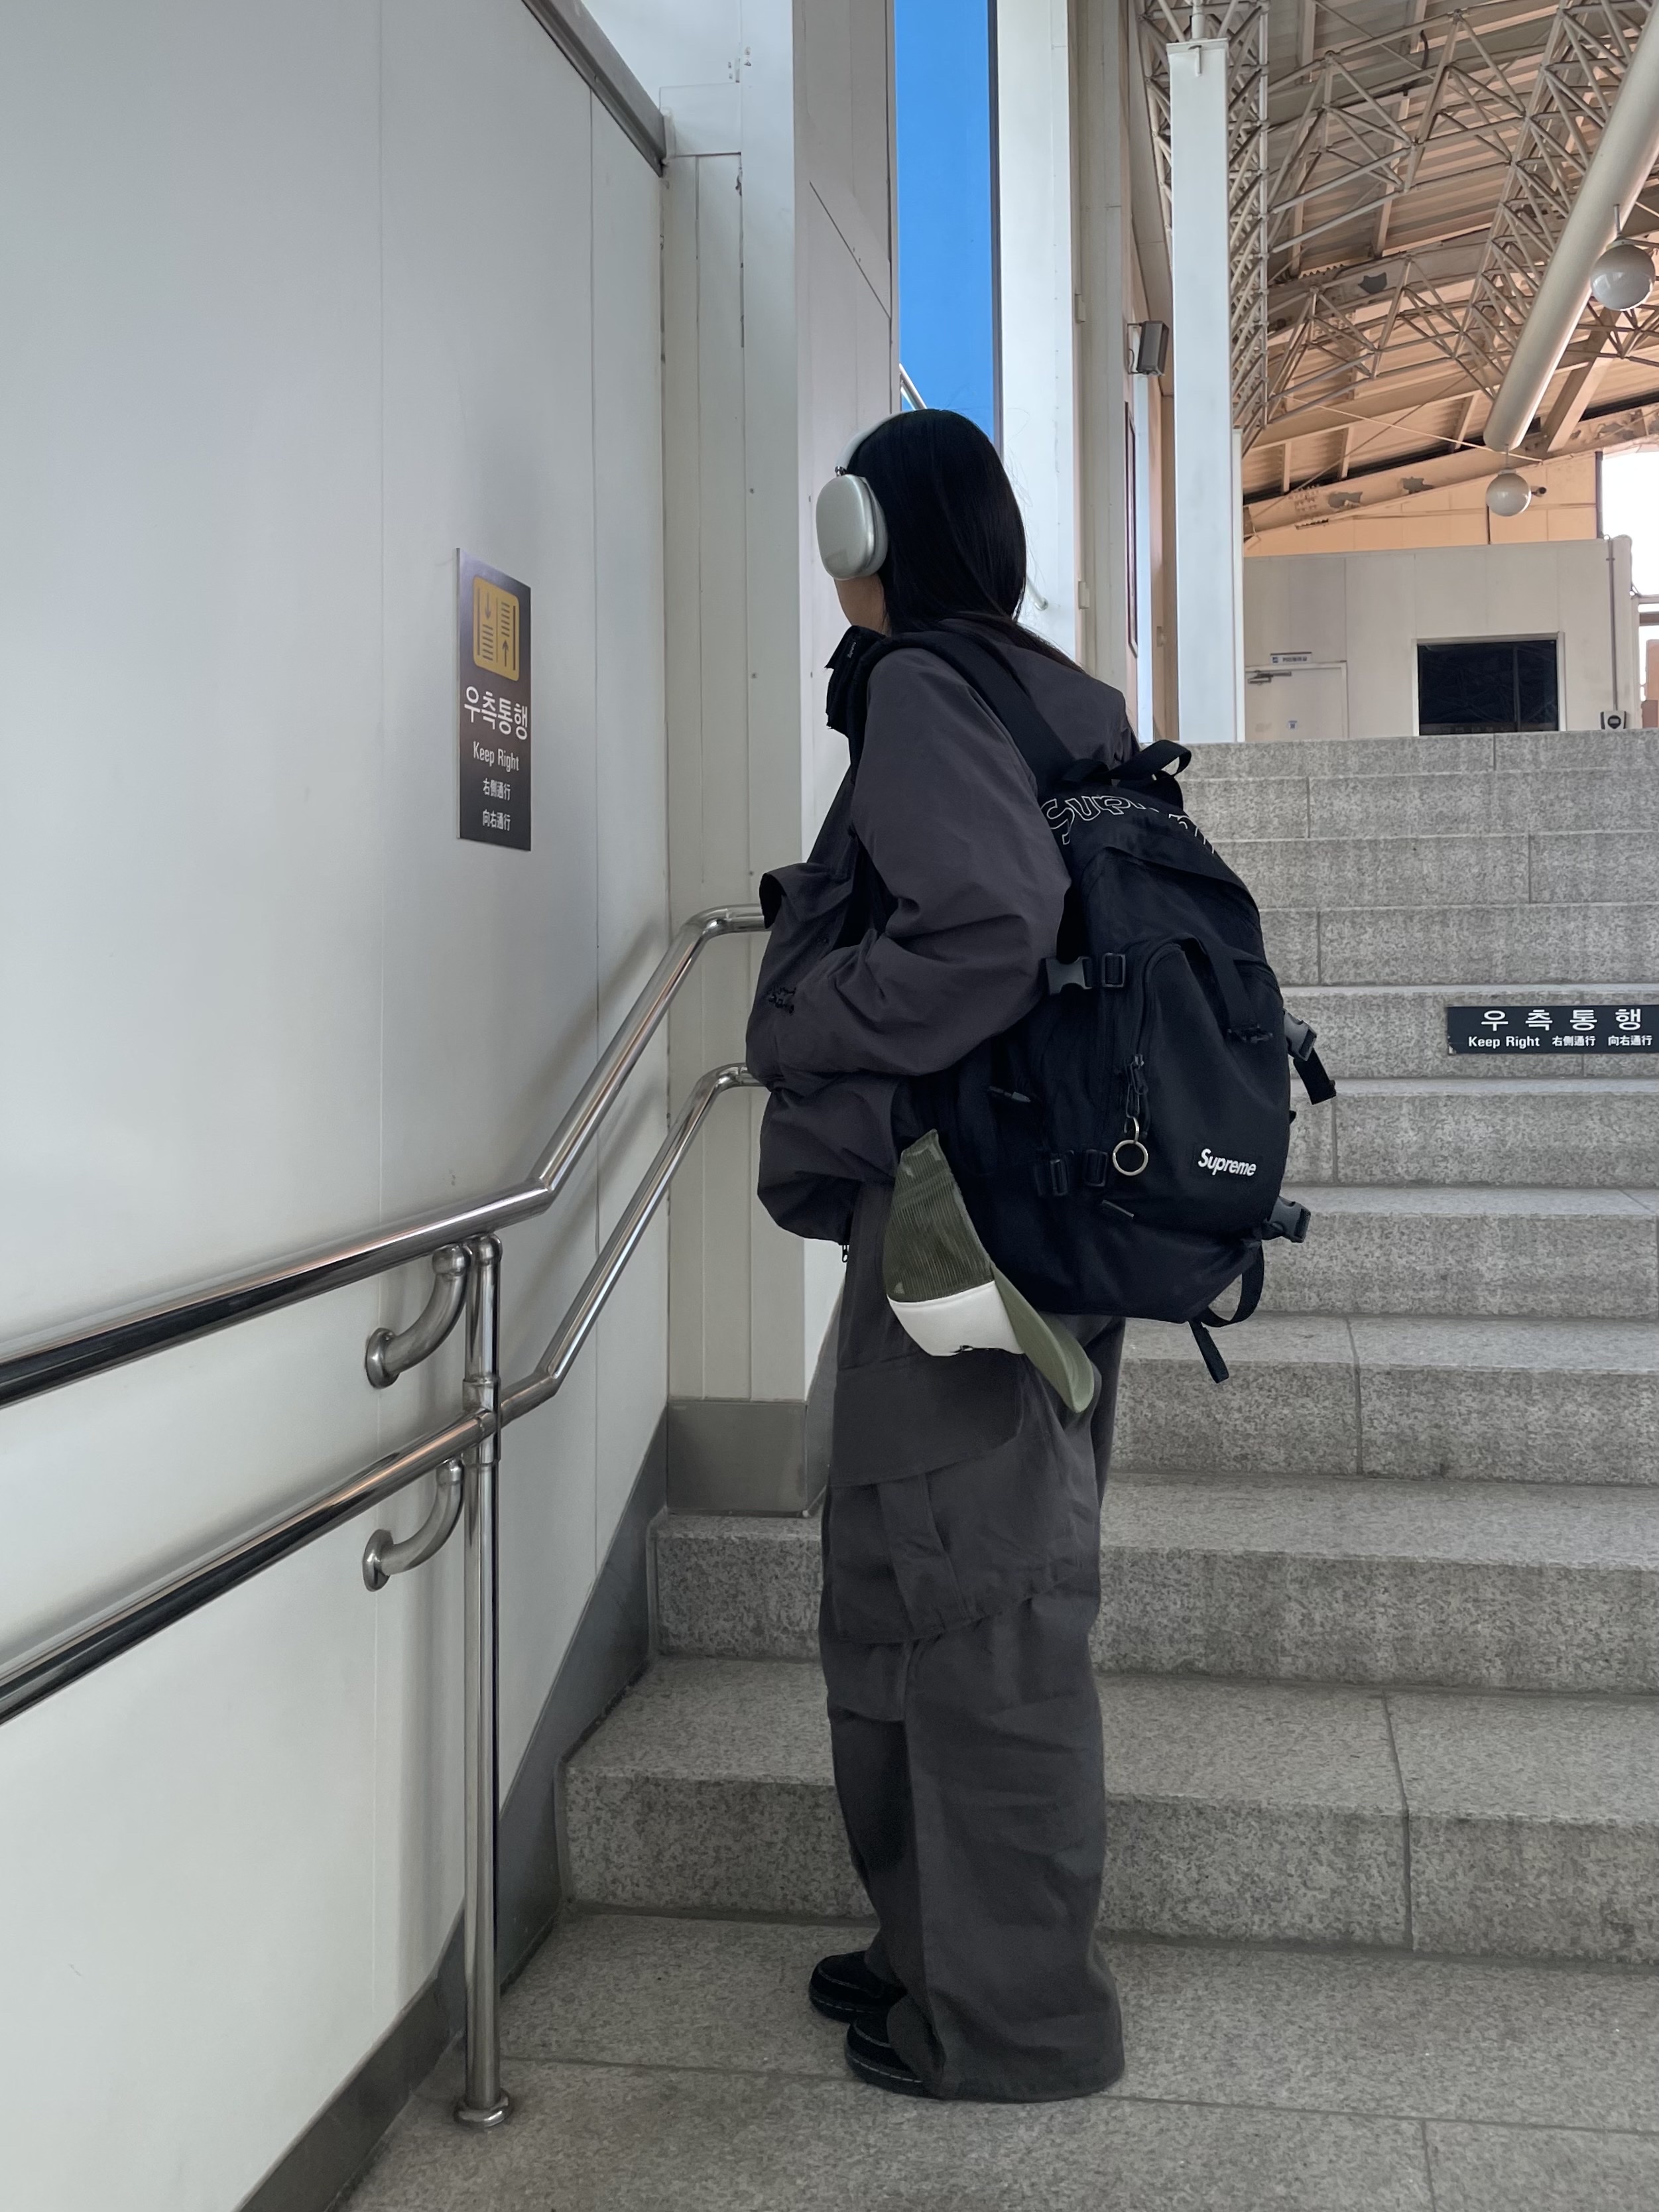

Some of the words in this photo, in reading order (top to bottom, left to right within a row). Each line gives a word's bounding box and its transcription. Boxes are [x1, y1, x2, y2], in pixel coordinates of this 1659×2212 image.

[464, 686, 528, 741] 우측통행
[473, 741, 495, 767] Keep
[497, 748, 519, 772] Right
[1469, 1036, 1500, 1048] Keep
[1506, 1036, 1540, 1048] Right
[1552, 1036, 1595, 1046] 右側通行
[1609, 1035, 1652, 1046] 向右通行
[1198, 1148, 1256, 1176] Supreme
